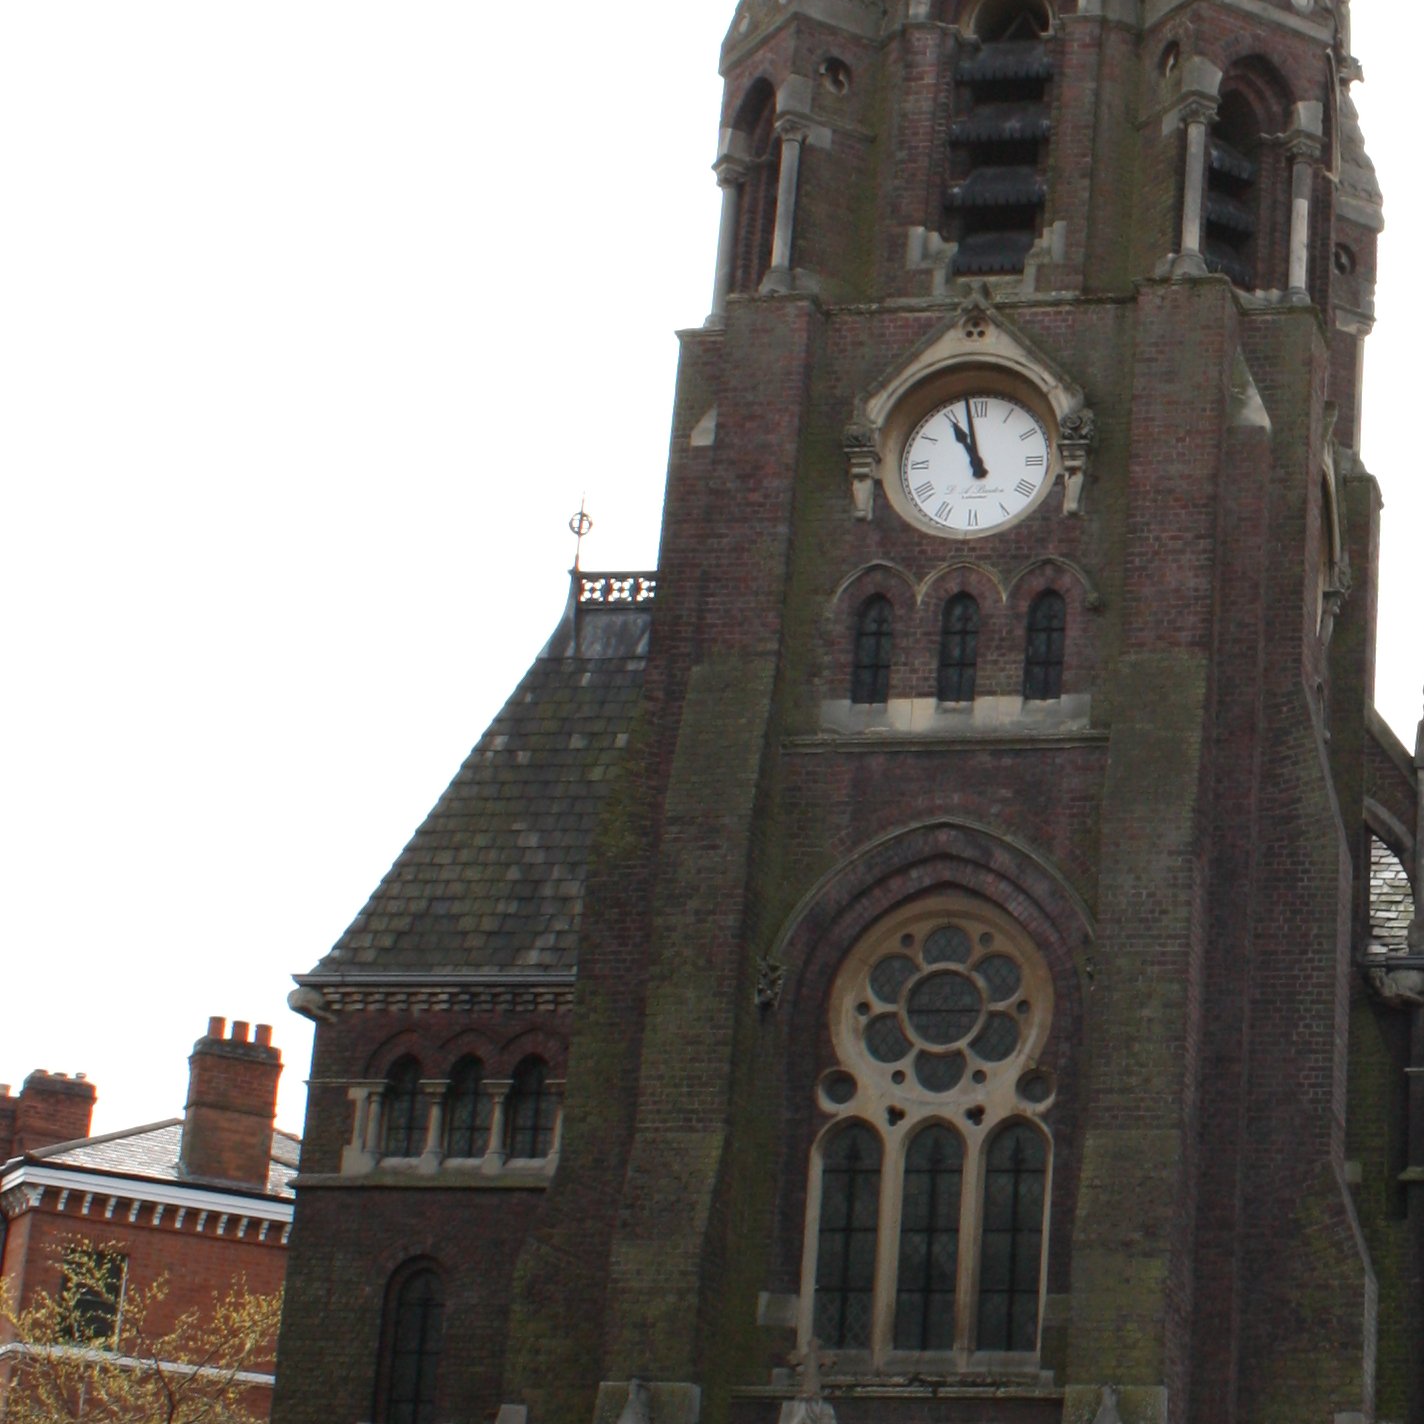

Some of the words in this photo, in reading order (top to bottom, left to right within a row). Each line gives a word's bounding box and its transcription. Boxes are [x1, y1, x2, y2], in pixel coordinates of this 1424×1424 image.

[973, 401, 988, 418] XII
[1019, 427, 1037, 441] II
[1026, 455, 1043, 466] III
